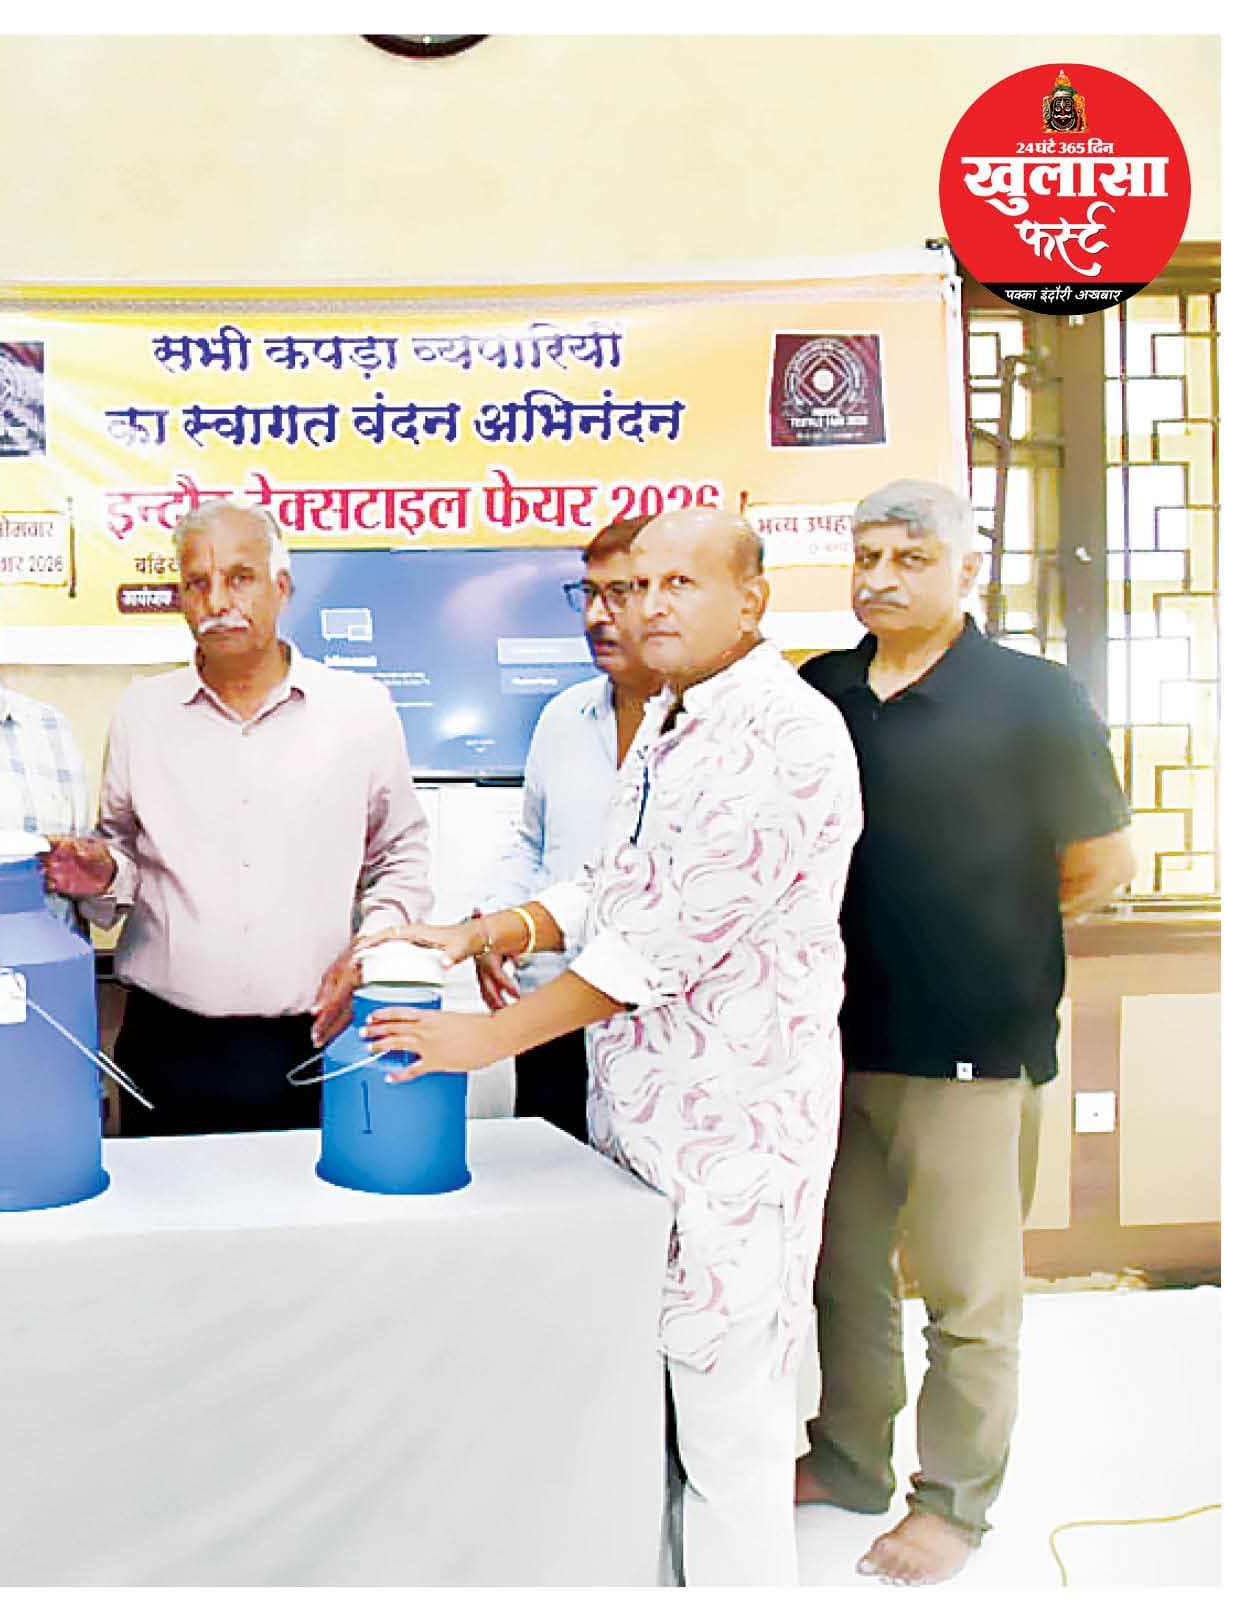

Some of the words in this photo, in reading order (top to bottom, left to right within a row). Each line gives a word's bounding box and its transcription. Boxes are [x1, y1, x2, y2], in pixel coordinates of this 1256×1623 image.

[152, 325, 252, 373] सभी
[263, 335, 398, 380] कपड़ा
[105, 407, 169, 446] का
[182, 404, 340, 447] स्वागत
[352, 391, 461, 445] वंदन
[474, 389, 686, 443] अभिनंदन
[483, 469, 598, 528] फेयर
